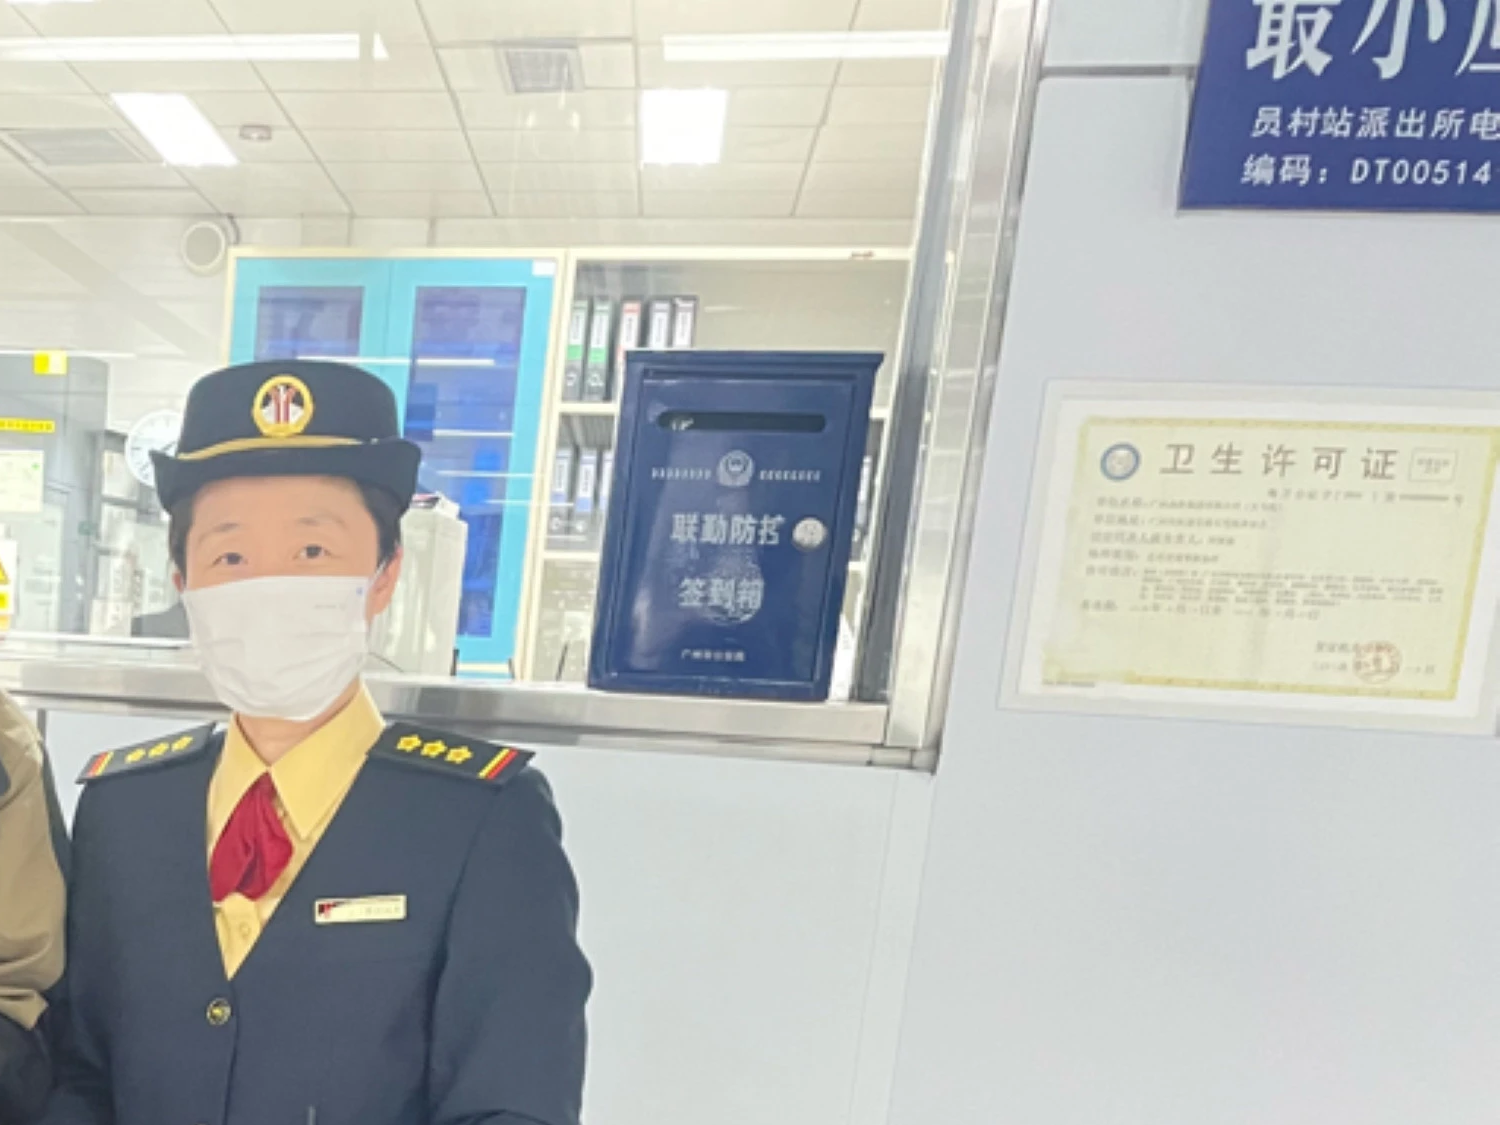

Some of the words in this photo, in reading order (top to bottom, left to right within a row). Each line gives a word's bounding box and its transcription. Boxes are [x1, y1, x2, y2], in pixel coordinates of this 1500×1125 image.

[1250, 106, 1500, 141] 员村站派出所电
[1159, 442, 1399, 481] 卫生许可证
